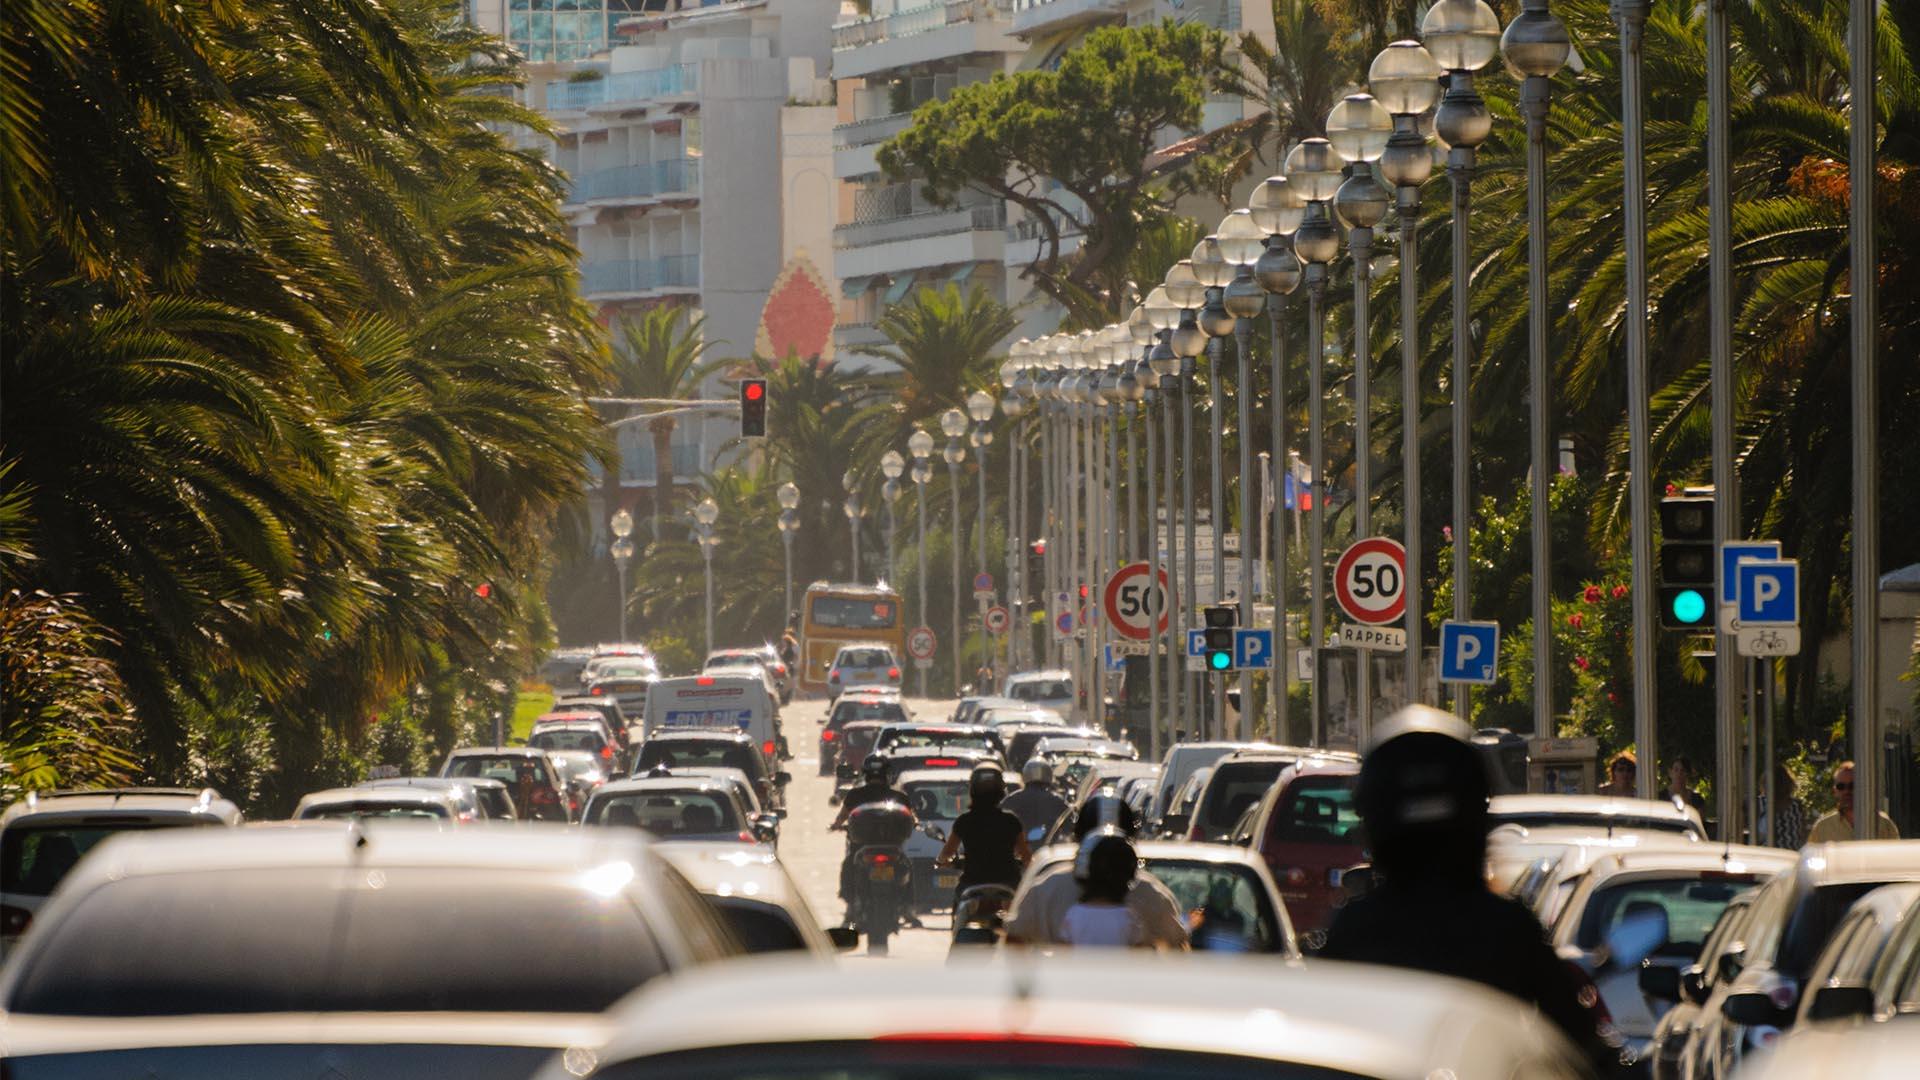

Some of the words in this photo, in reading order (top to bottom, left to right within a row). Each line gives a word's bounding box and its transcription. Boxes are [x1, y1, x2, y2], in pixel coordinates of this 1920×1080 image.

[1353, 564, 1399, 598] 50
[1754, 574, 1782, 612] P
[1121, 585, 1164, 617] 50
[1244, 637, 1262, 662] P
[1345, 628, 1401, 646] RAPPEL
[1456, 635, 1481, 671] P
